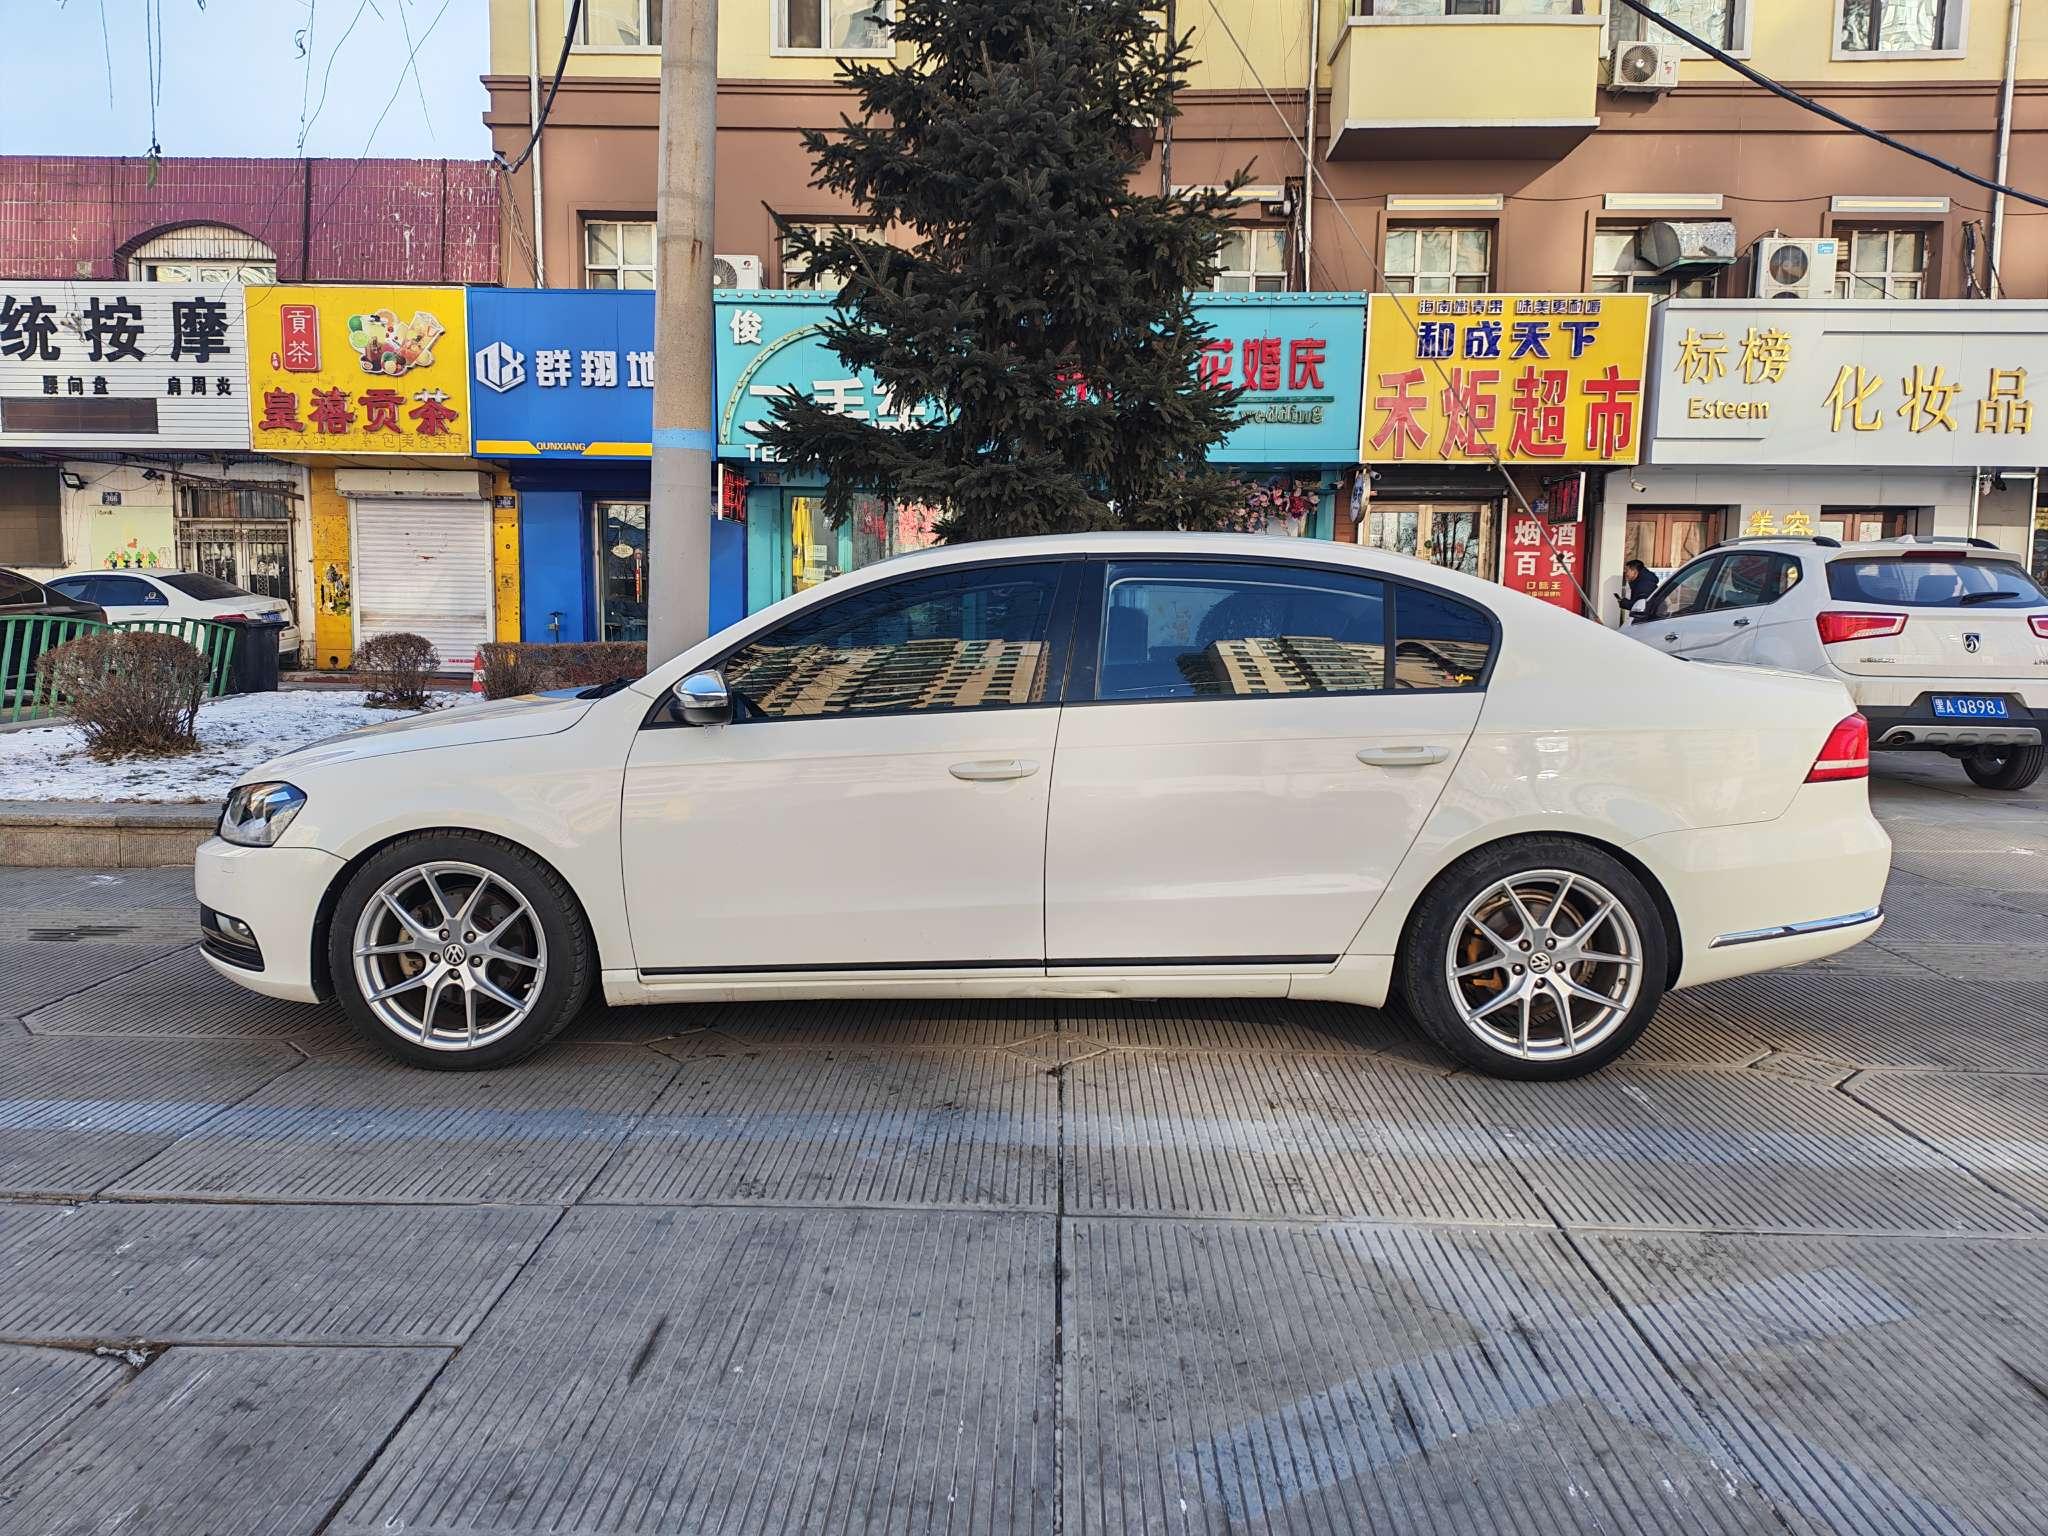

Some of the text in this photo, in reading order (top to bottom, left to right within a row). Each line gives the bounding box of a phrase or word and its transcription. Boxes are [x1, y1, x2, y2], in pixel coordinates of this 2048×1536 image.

[1419, 299, 1504, 314] 海南嫩青果
[0, 294, 231, 363] 统按摩
[730, 308, 763, 345] 俊
[1416, 320, 1600, 359] 和成天下
[1675, 327, 1794, 385] 标榜
[43, 375, 232, 396] 腰间盘 肩周炎
[1823, 364, 2033, 434] 化妆品
[258, 386, 460, 436] 皇禧贡茶
[1370, 364, 1641, 460] 禾炬超市
[1687, 397, 1770, 420] Esteem
[535, 442, 587, 451] QUNXIANG
[1513, 520, 1577, 547] 烟酒
[1744, 511, 1814, 536] 美容
[1513, 551, 1577, 577] 百货
